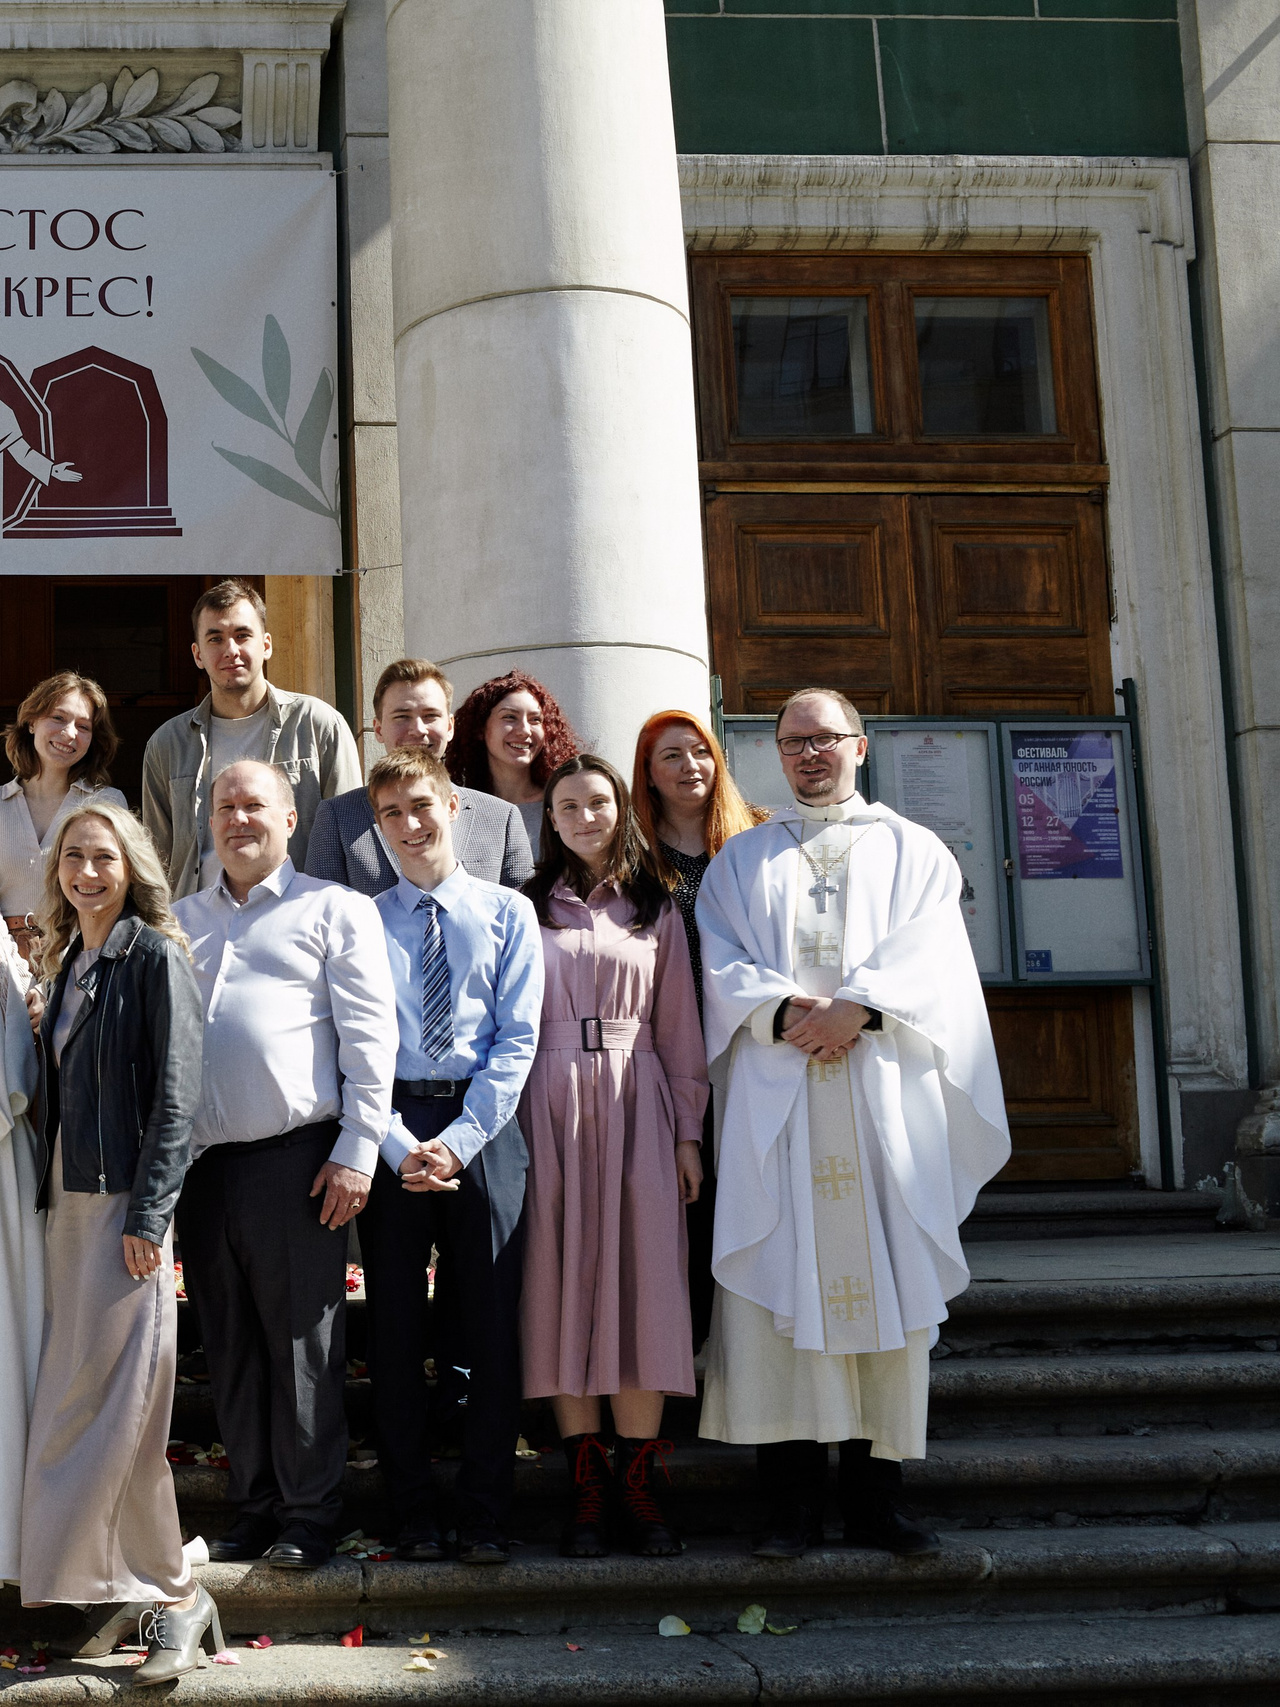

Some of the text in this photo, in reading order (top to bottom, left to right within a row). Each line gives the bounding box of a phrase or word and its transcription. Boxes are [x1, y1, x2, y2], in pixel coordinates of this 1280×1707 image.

[1017, 747, 1069, 759] ФЕСТИВАЛЬ
[1018, 762, 1097, 773] ОРГАННАЯ ЮНОСТЬ
[1019, 776, 1053, 787] РОССИИ
[1018, 793, 1034, 805] 05
[1021, 816, 1060, 827] 12 27
